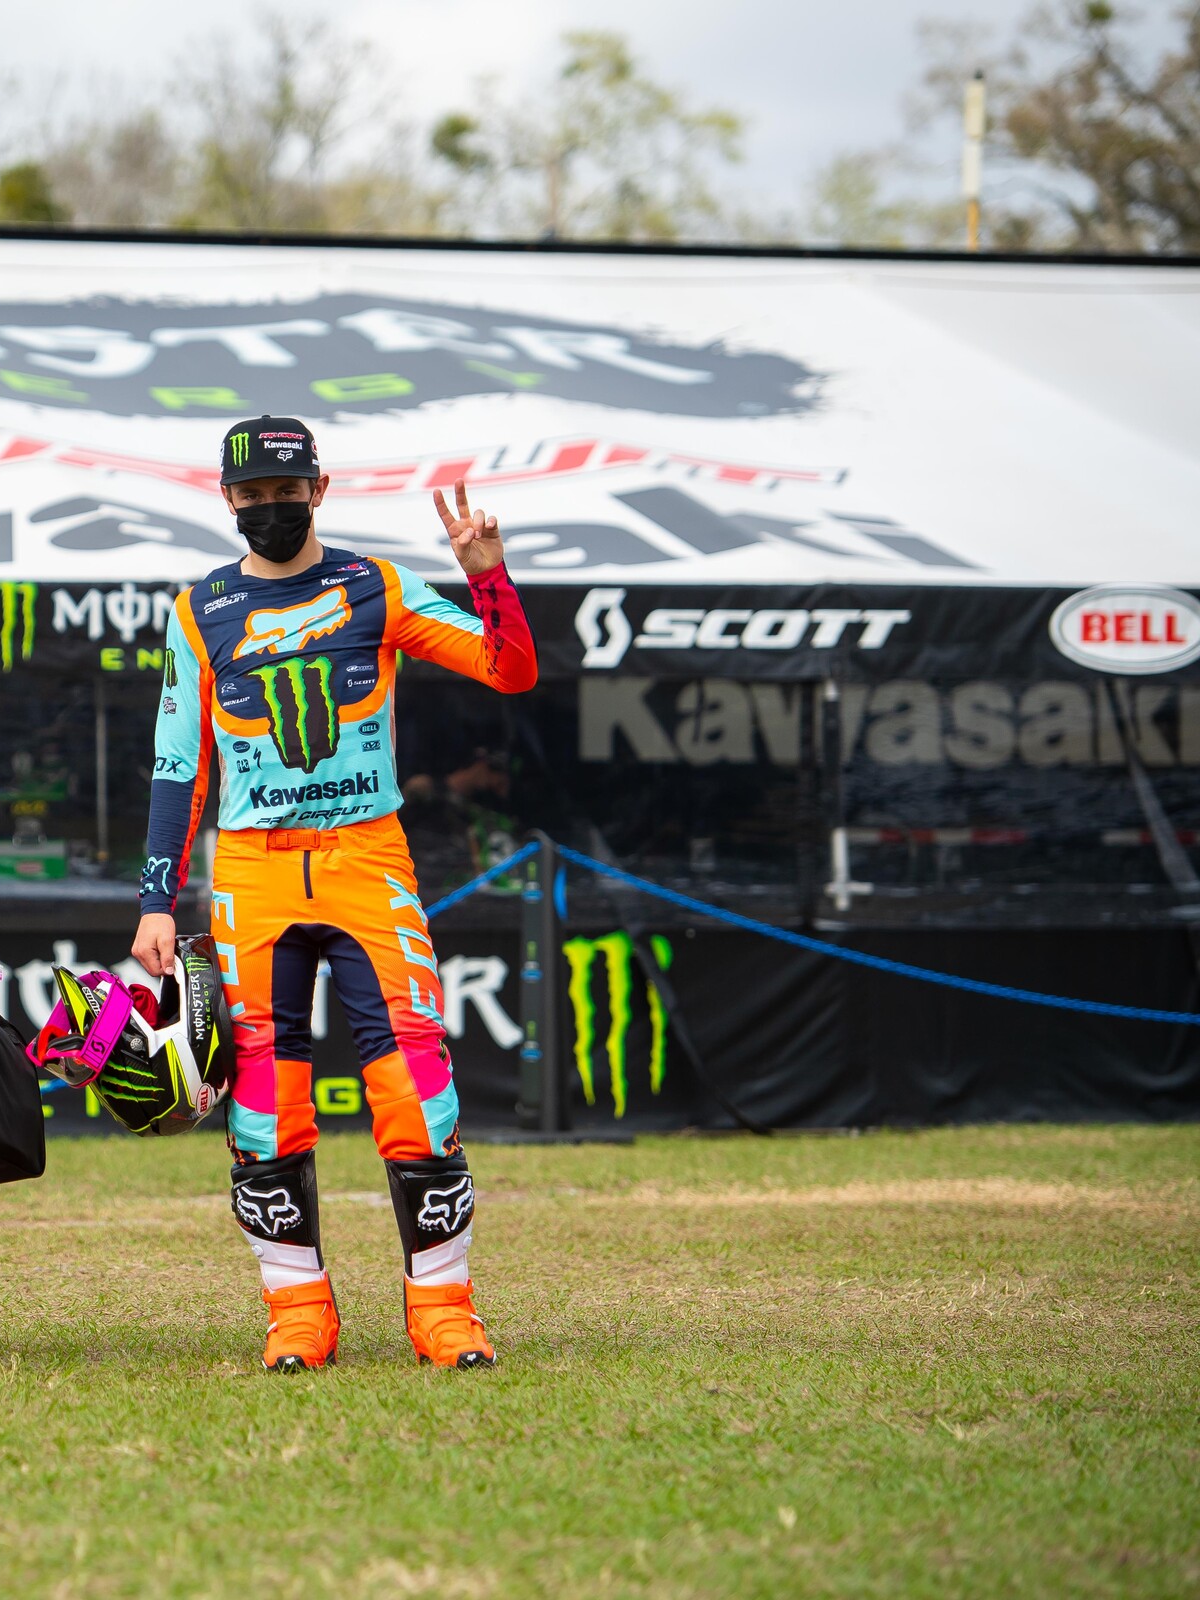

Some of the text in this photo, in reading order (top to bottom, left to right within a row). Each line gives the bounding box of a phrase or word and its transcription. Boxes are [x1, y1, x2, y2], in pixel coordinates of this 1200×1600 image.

[263, 440, 303, 450] Kawasaki
[203, 596, 228, 609] PRO
[204, 594, 248, 615] CIRCUIT
[634, 609, 911, 650] SCOTT
[1080, 611, 1187, 645] BELL
[353, 678, 376, 686] SCOTT
[222, 696, 251, 707] DUNLOP
[361, 724, 378, 733] BELL
[249, 769, 379, 810] Kawasaki
[297, 803, 374, 821] CIRCUIT
[384, 872, 446, 1027] FOX
[192, 972, 205, 1041] MONSTER
[199, 1087, 209, 1112] BELL
